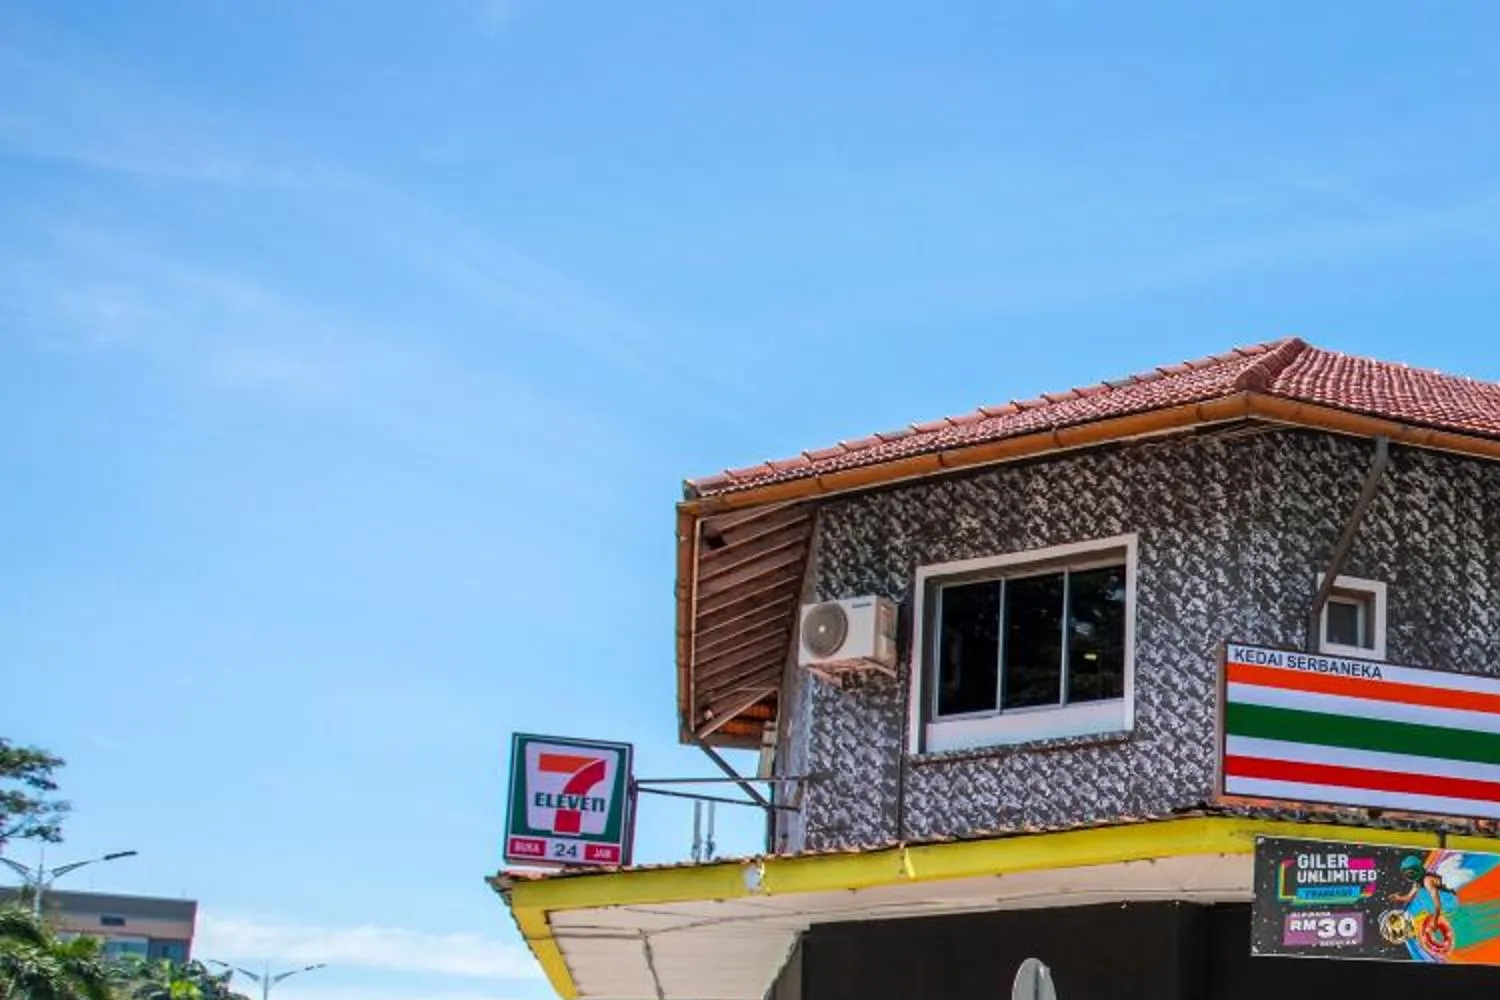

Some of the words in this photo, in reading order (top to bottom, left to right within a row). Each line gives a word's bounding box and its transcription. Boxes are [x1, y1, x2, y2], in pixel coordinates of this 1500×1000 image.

[1234, 647, 1284, 669] KEDAI
[1286, 654, 1383, 680] SERBANEKA
[538, 753, 607, 834] 7
[554, 843, 578, 858] 24
[1297, 853, 1349, 869] GILER
[1297, 869, 1377, 883] UNLIMITED
